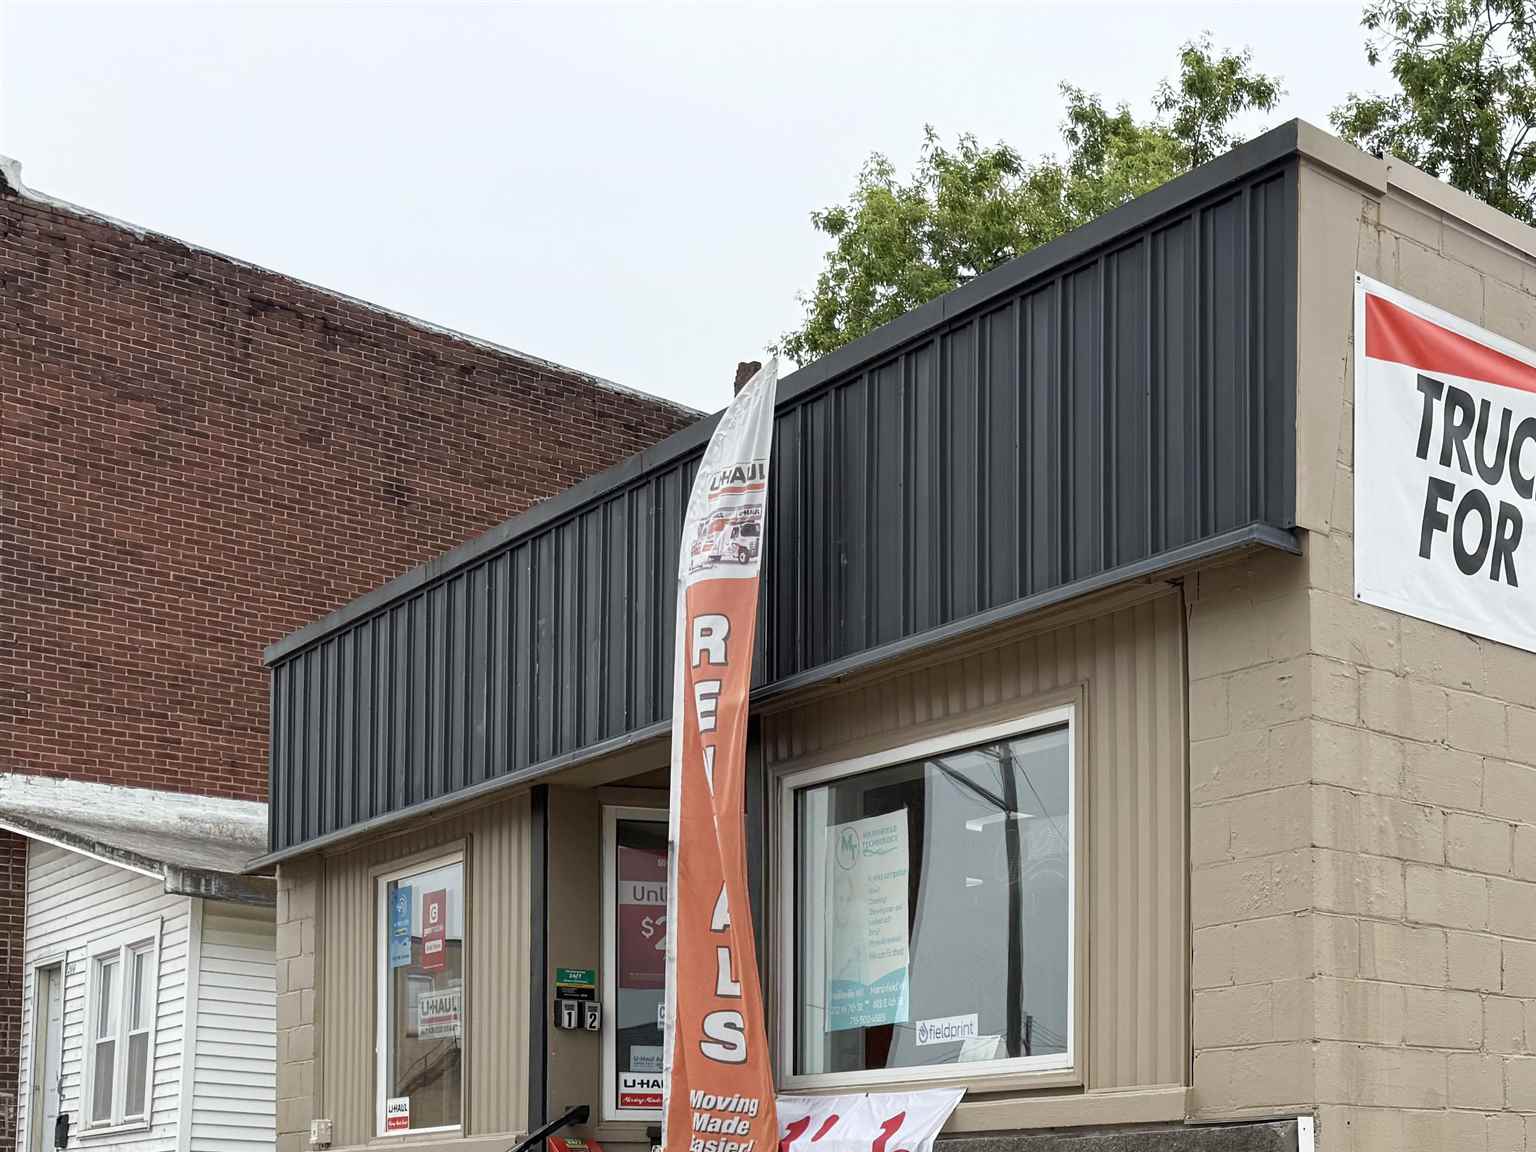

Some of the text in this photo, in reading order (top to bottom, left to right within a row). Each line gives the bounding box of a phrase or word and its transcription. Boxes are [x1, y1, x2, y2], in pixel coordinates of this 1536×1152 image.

[1418, 475, 1523, 588] FOR
[929, 1022, 974, 1040] fieldprint
[623, 1079, 664, 1089] U-HA
[690, 1088, 759, 1119] Moving
[692, 1112, 751, 1136] Made
